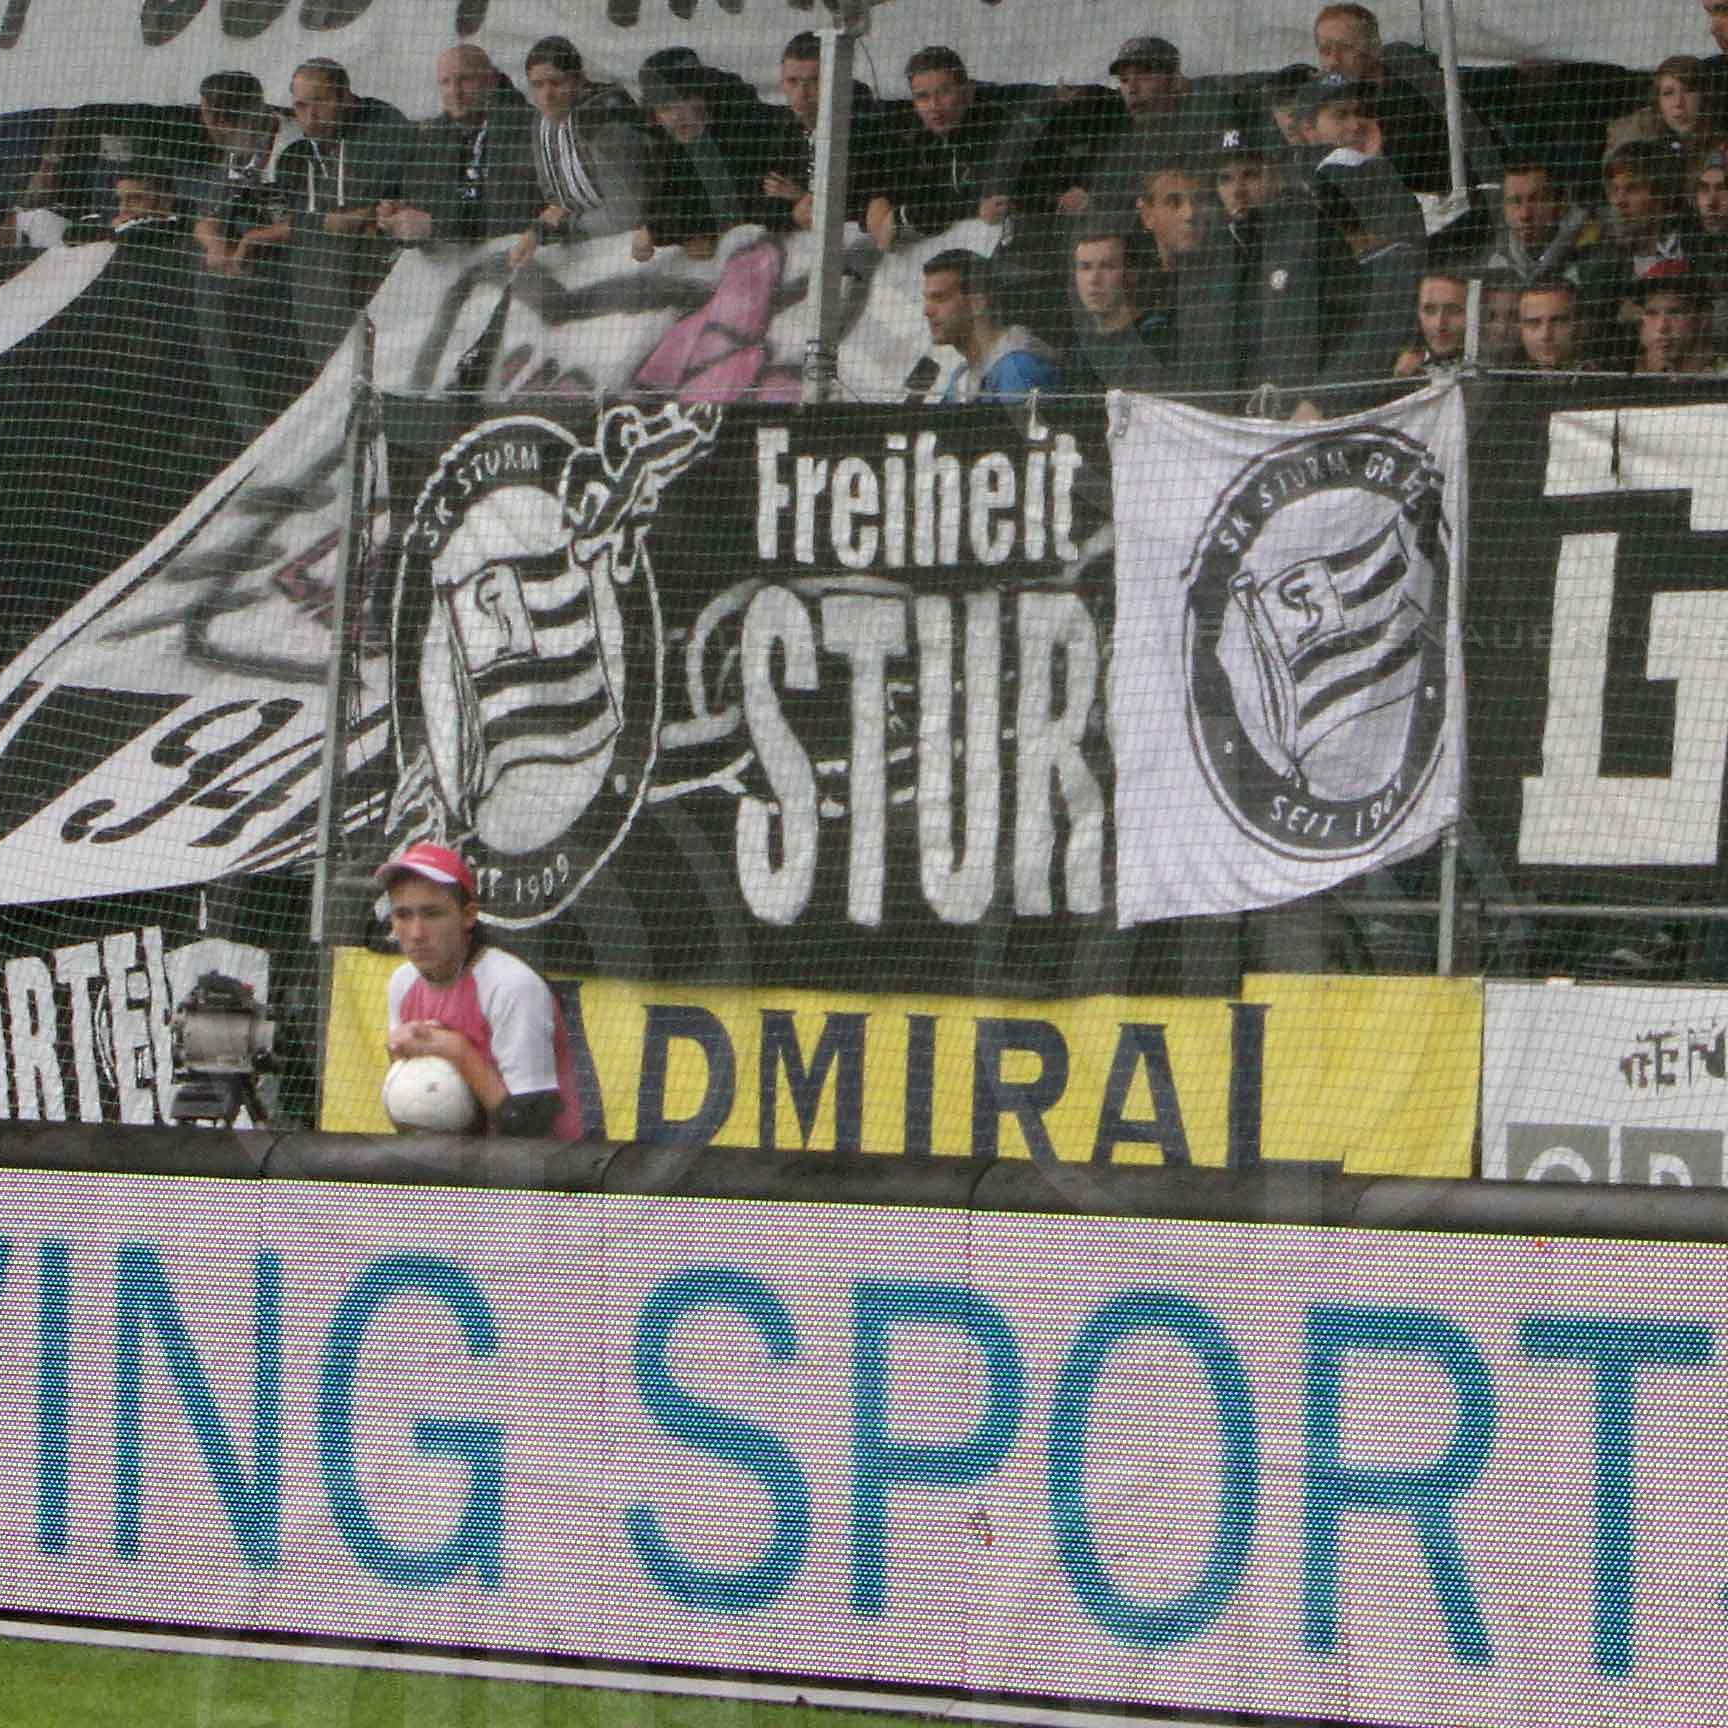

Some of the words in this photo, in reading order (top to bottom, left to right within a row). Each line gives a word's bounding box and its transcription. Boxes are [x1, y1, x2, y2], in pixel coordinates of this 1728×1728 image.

[456, 440, 542, 496] STURM
[1257, 449, 1351, 509] STURM
[755, 426, 1085, 569] Freiheit
[1270, 794, 1337, 838] SEIT
